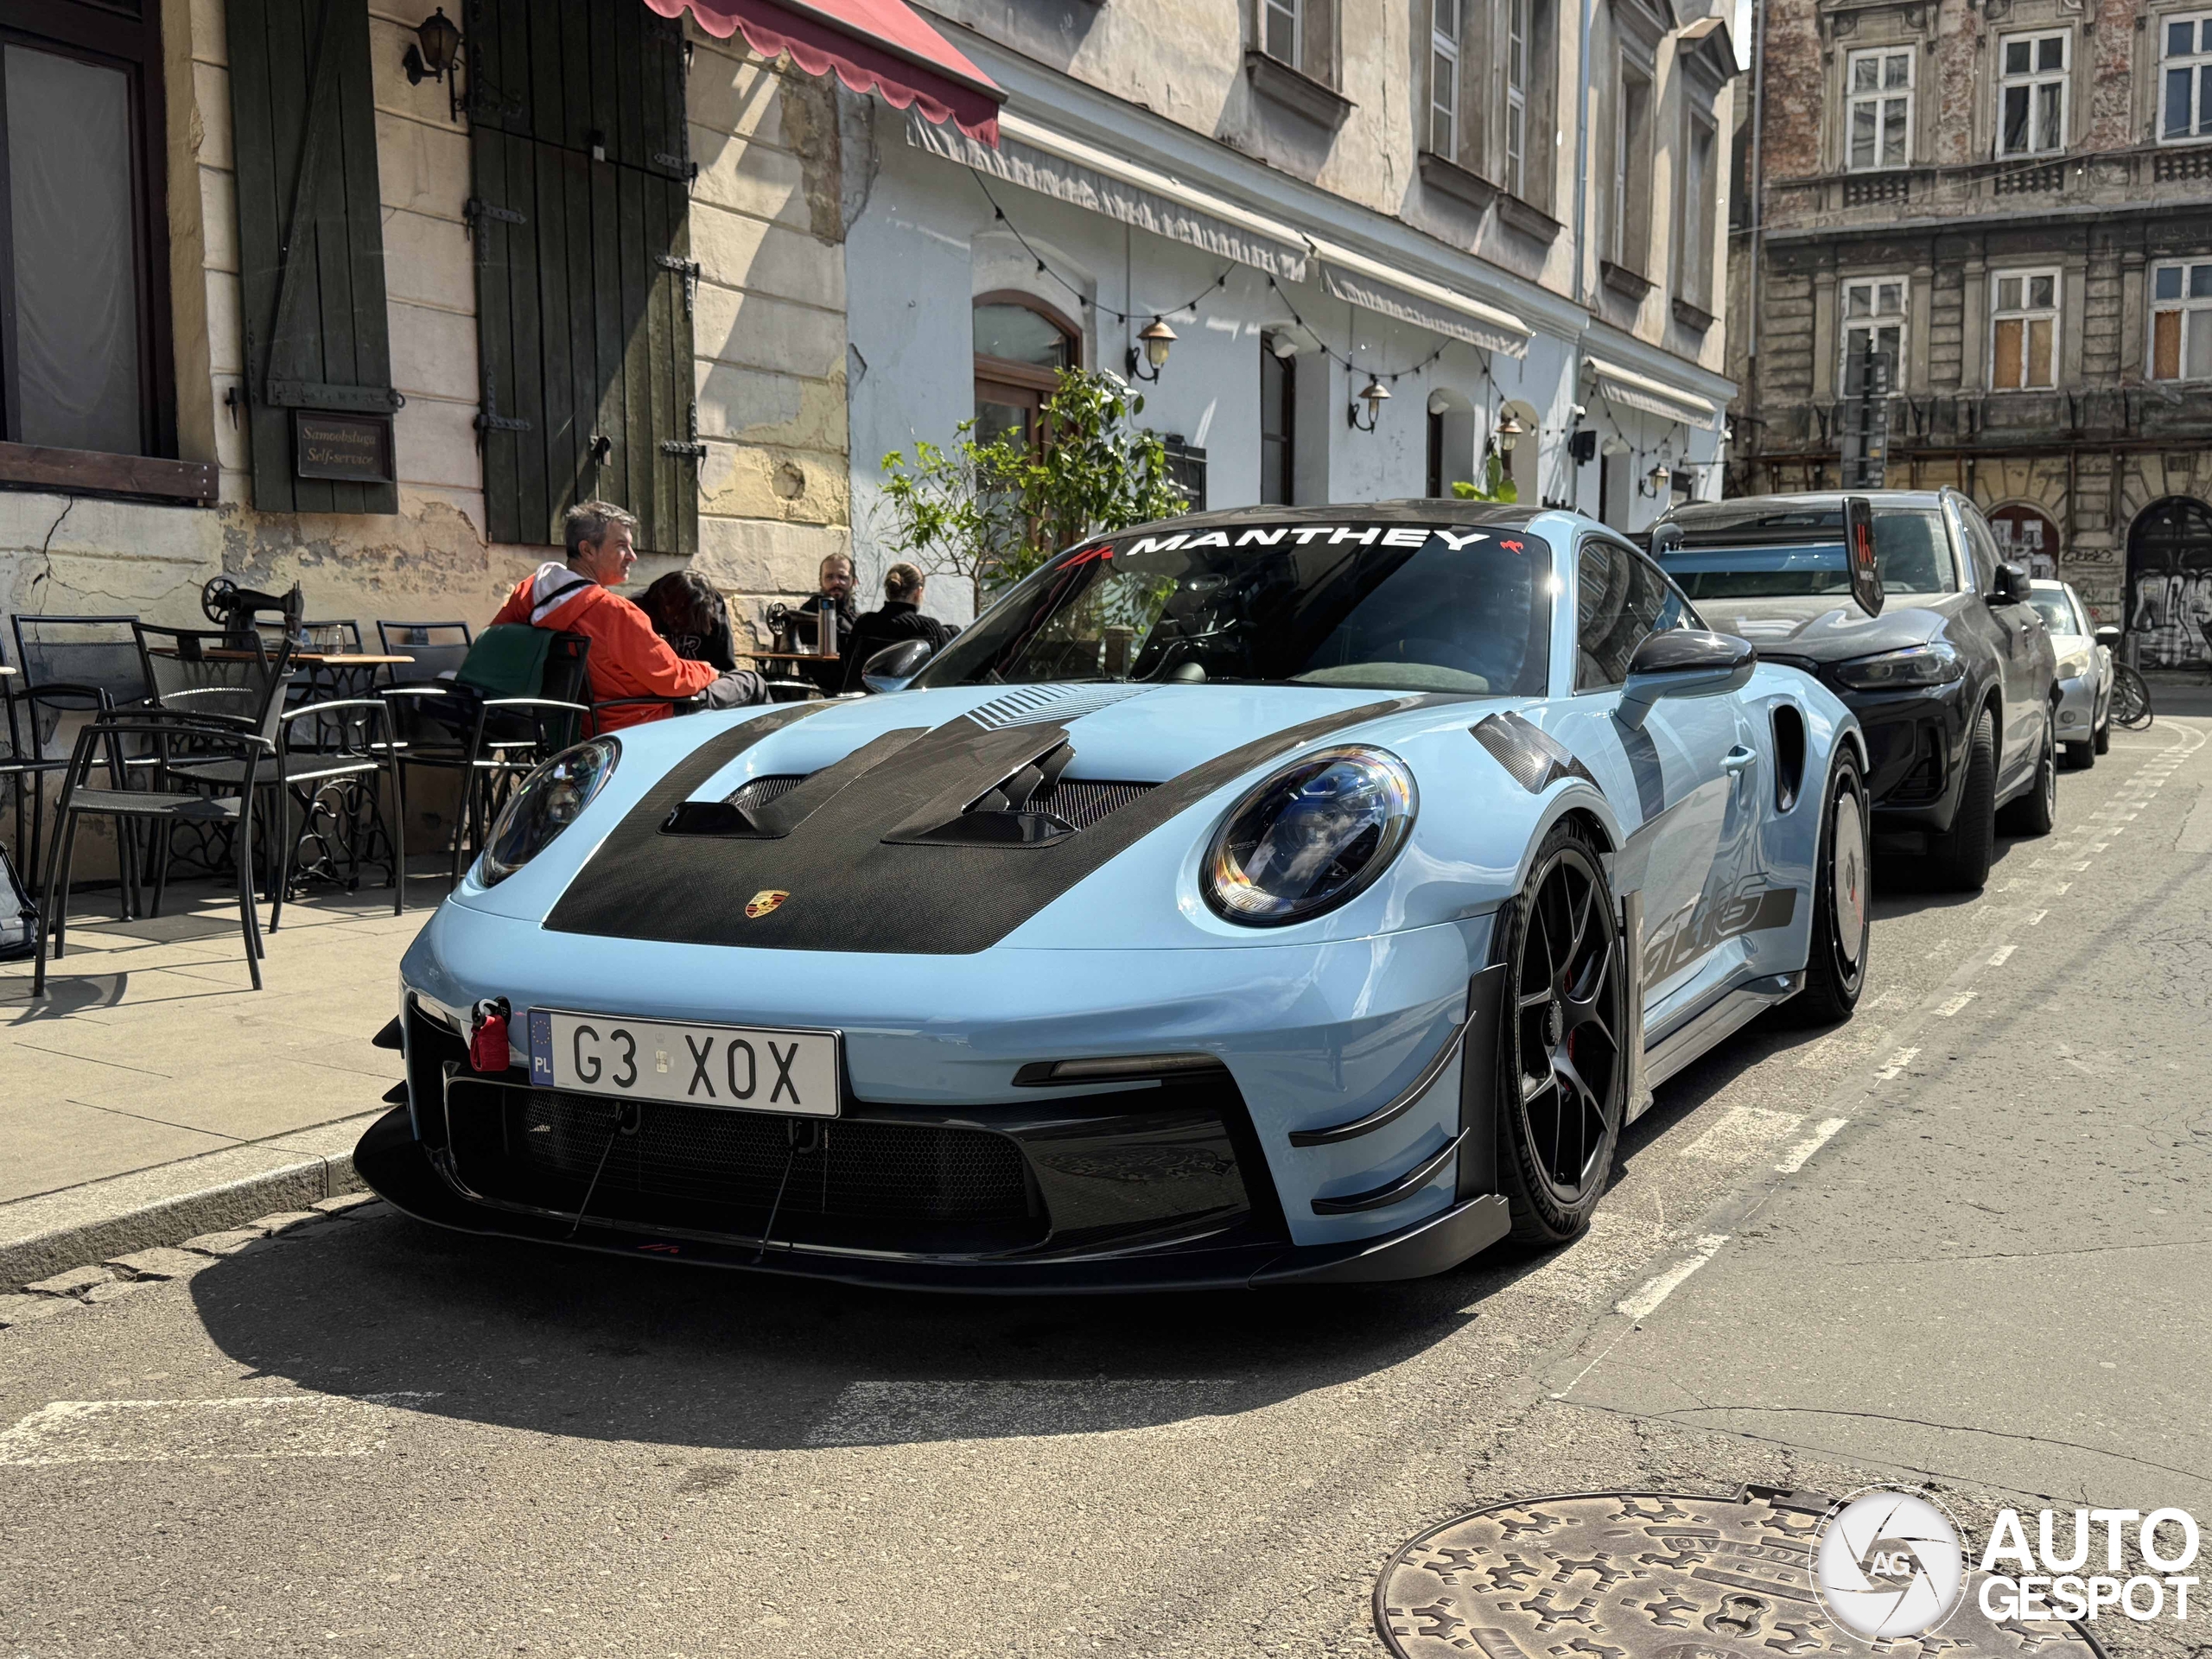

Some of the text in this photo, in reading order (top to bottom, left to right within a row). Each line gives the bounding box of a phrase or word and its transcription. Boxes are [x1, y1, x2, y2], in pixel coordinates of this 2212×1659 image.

[308, 448, 373, 465] Self-service
[1127, 528, 1490, 556] MANTHEY
[535, 1057, 551, 1074] PL
[574, 1026, 801, 1104] G3 XOX
[1519, 1143, 1558, 1224] MICHELIN
